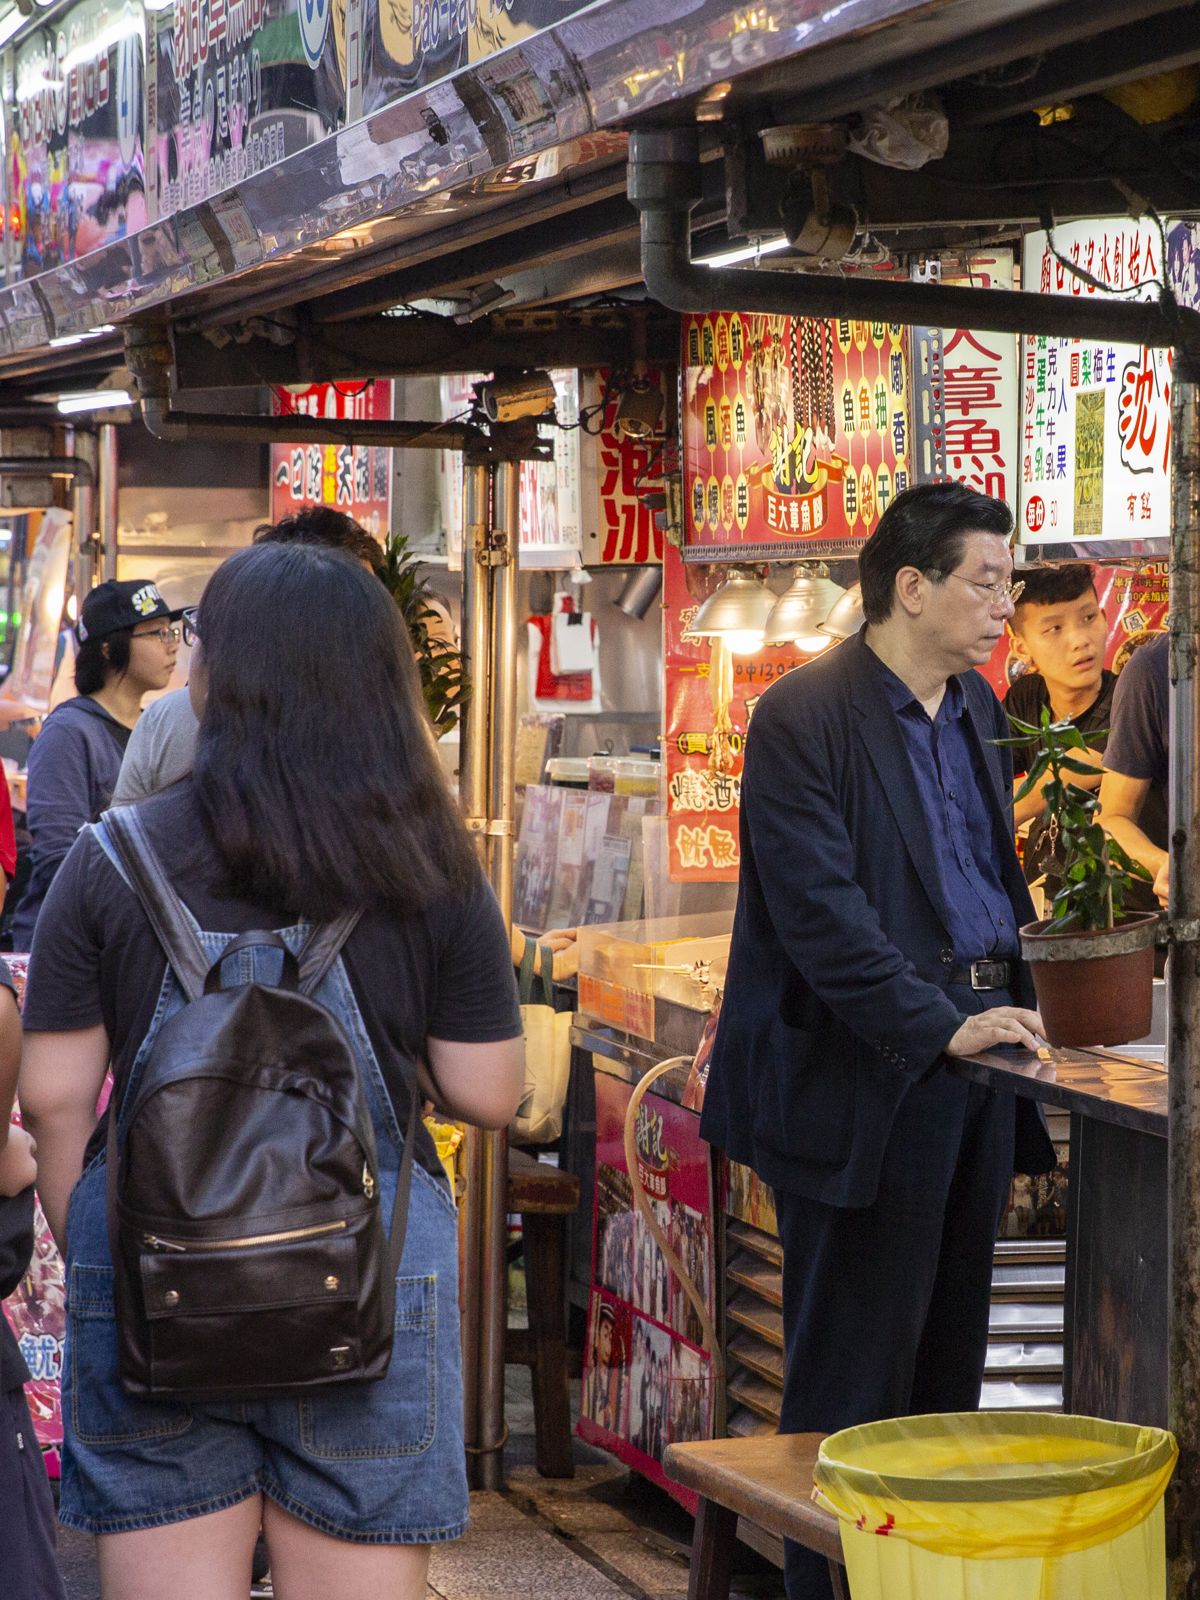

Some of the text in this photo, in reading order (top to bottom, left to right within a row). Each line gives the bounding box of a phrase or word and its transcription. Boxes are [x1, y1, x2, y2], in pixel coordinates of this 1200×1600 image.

[1046, 336, 1057, 480] 克力牛乳
[769, 421, 819, 486] 謝記
[768, 494, 823, 533] 巨大章魚腳
